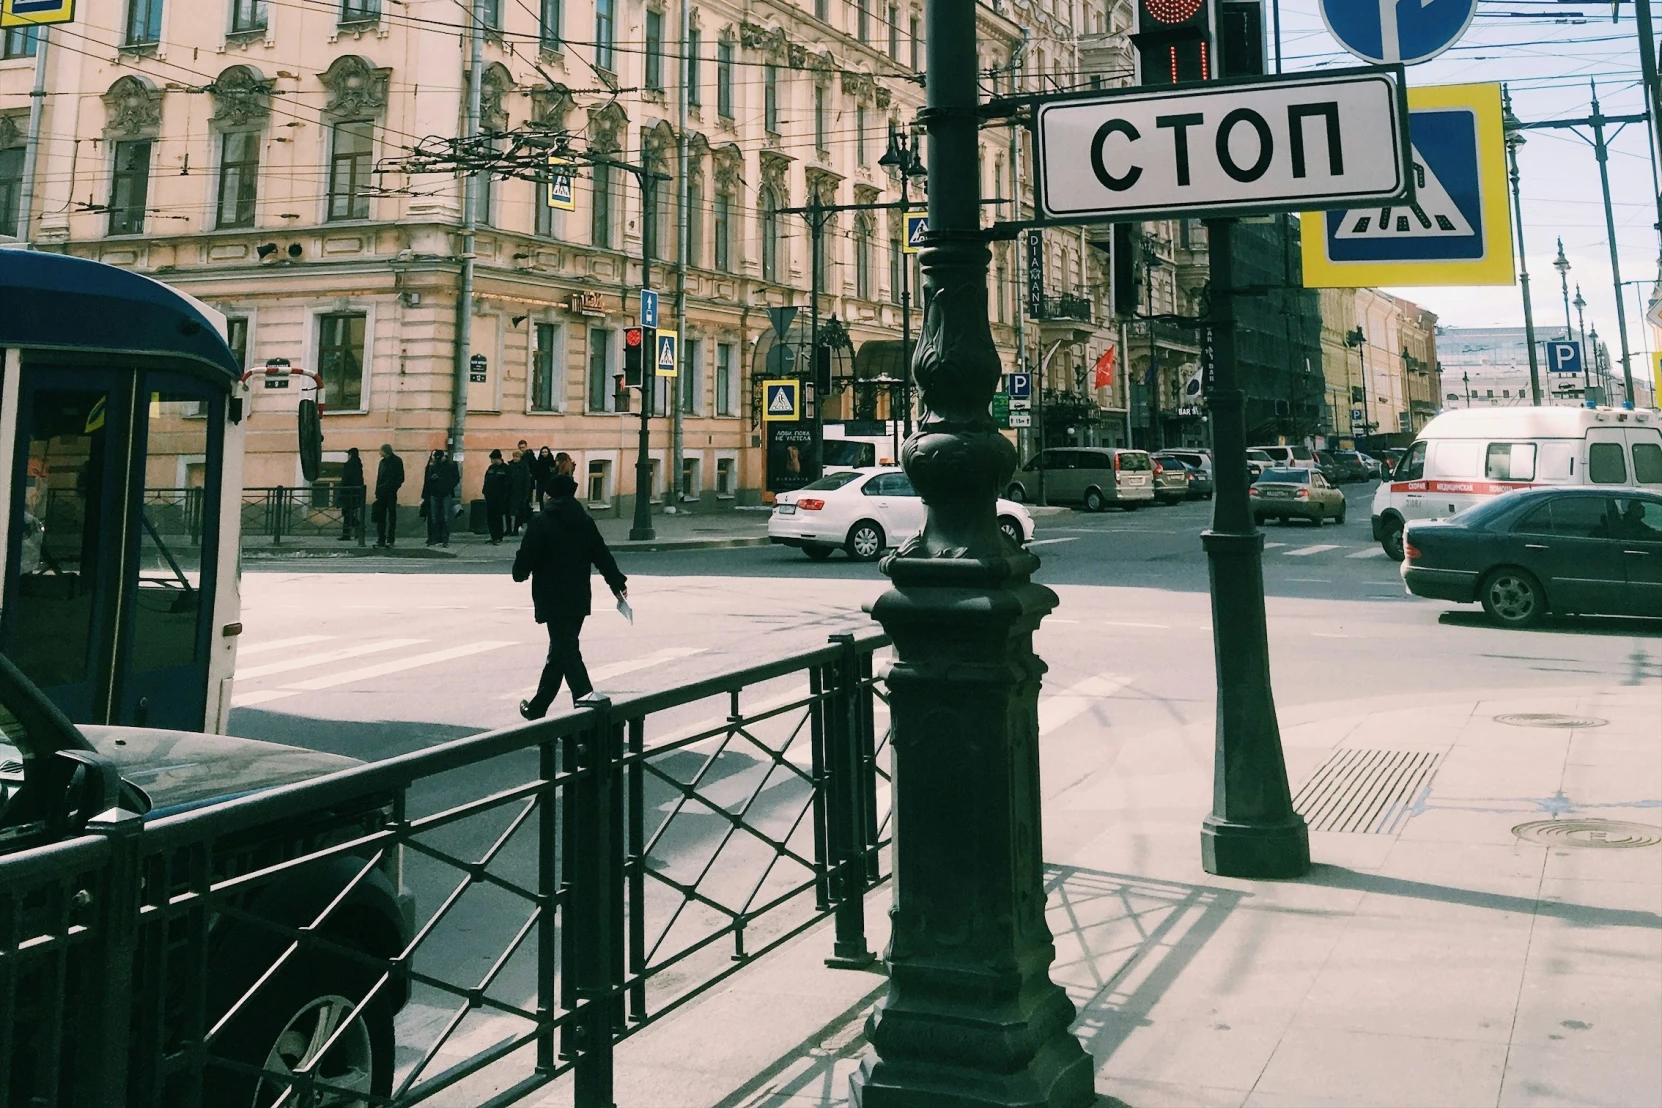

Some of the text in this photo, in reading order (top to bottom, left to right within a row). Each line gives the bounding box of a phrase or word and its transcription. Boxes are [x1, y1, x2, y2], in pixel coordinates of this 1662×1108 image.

[1090, 100, 1346, 193] СТОП
[1029, 235, 1042, 314] DIAMANT
[1555, 344, 1576, 370] P
[1014, 375, 1027, 394] P
[1178, 408, 1191, 416] BAR
